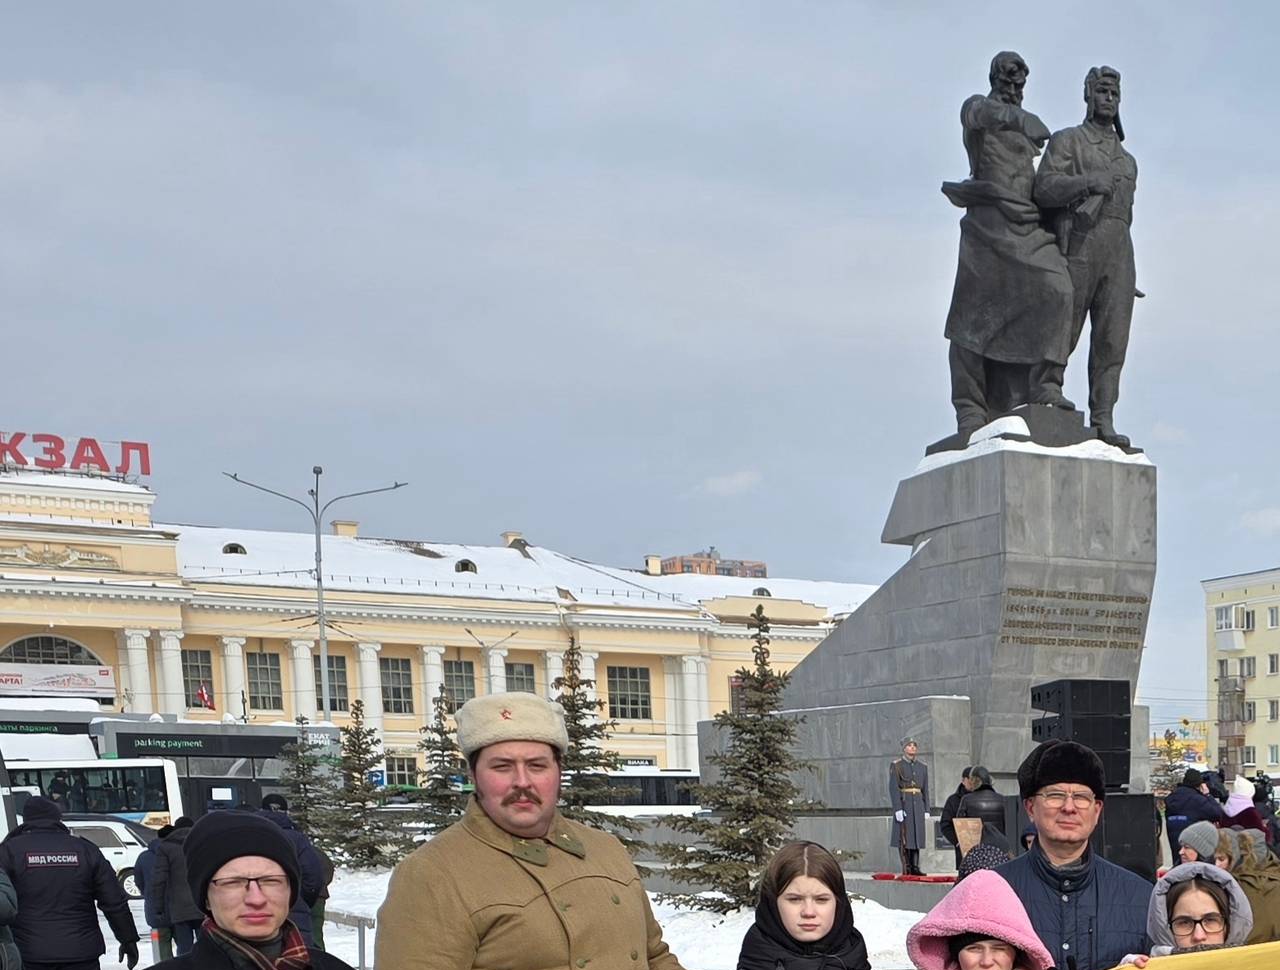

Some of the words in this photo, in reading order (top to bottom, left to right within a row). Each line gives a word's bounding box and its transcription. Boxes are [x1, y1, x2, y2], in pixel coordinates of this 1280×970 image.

[0, 432, 150, 475] КЗАЛ
[134, 738, 166, 748] parking
[167, 739, 204, 749] payment
[28, 855, 46, 864] МВД
[47, 855, 78, 863] РОССИИ
